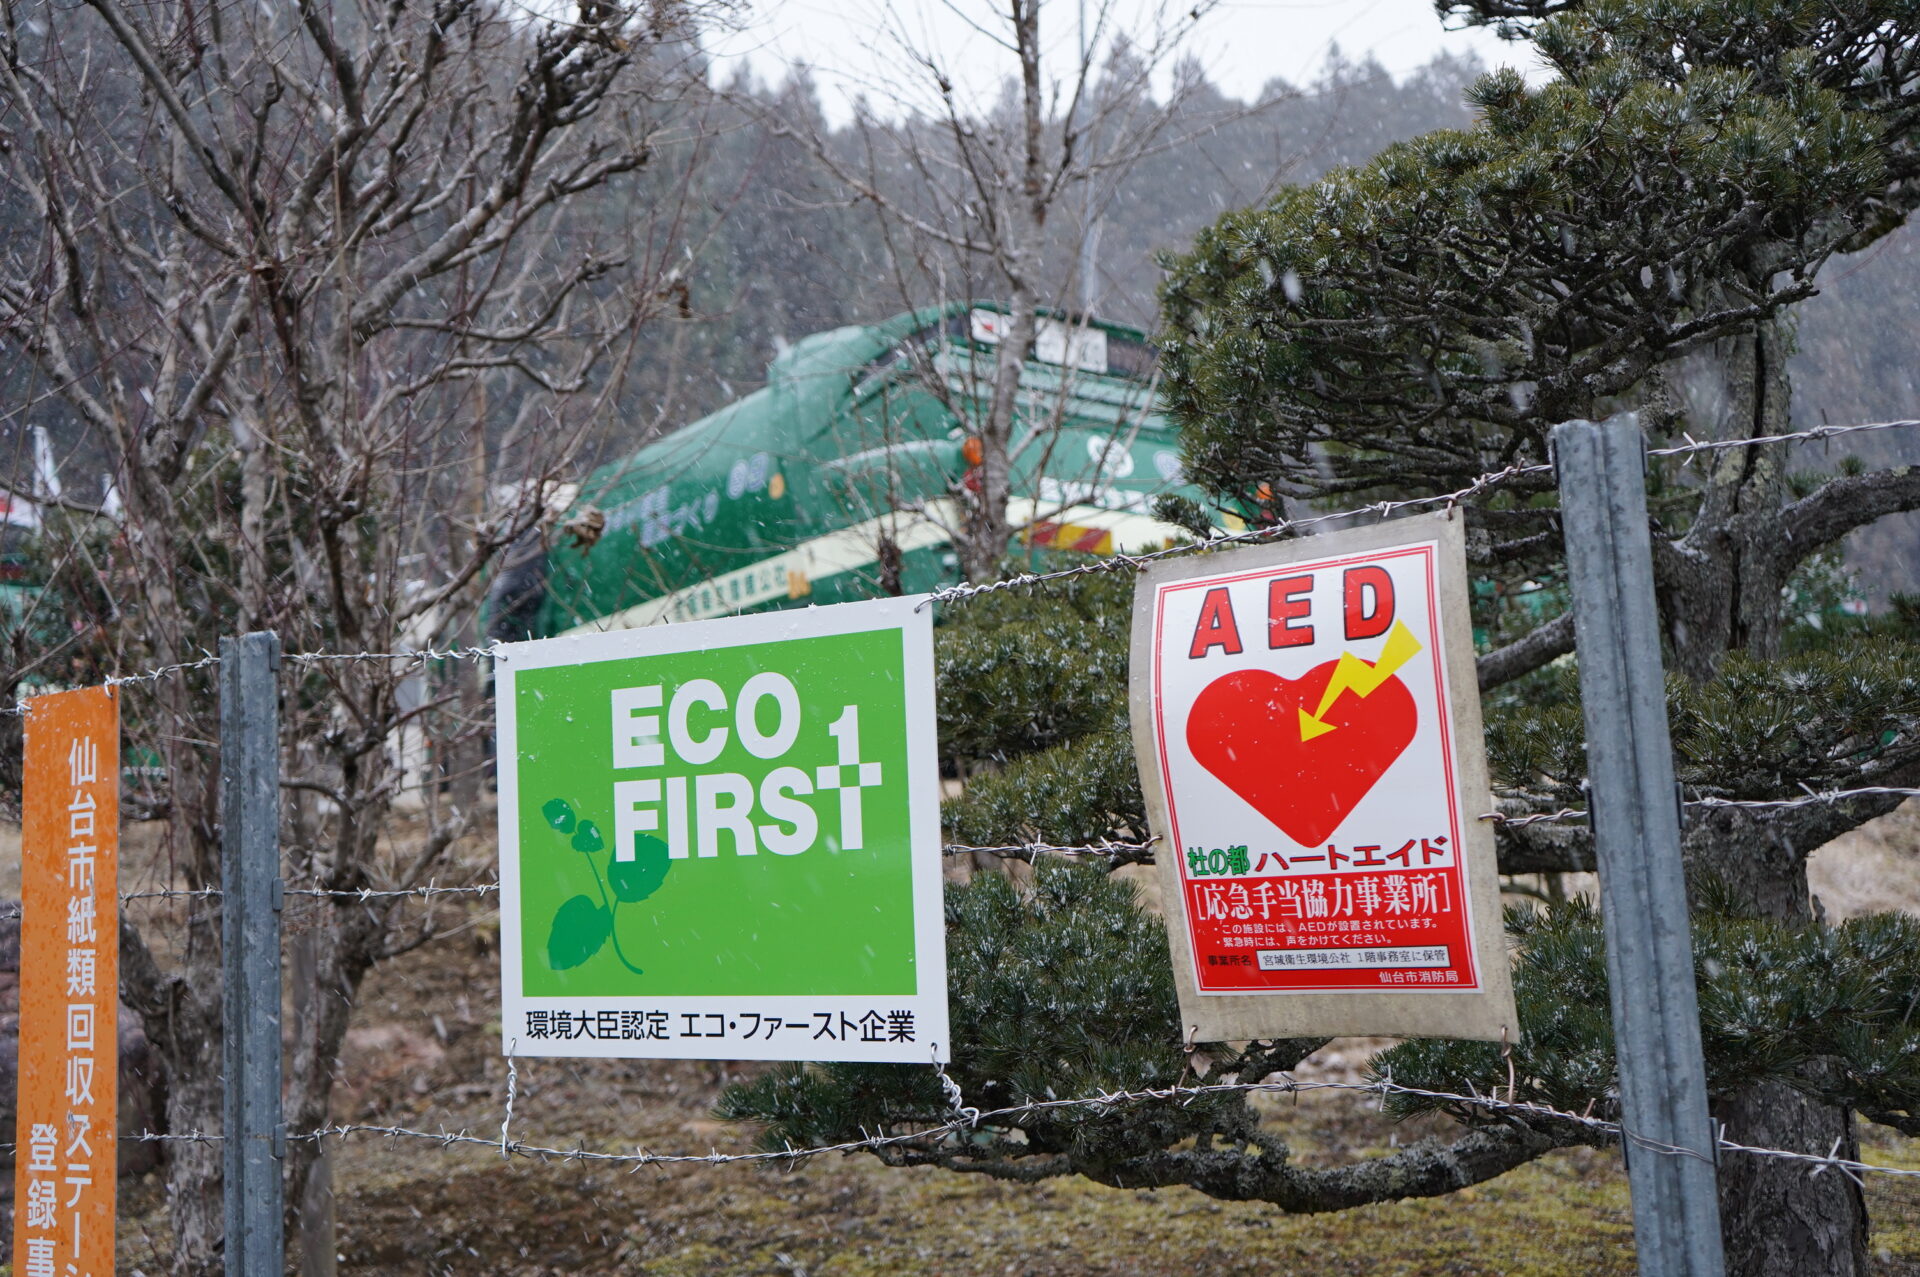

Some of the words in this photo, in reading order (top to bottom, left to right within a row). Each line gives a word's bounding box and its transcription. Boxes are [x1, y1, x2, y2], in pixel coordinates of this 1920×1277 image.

[1189, 565, 1396, 660] AED
[611, 672, 801, 769] ECO
[613, 761, 883, 862] FIRST
[1187, 844, 1251, 877] 杜の都
[1254, 835, 1449, 873] ハートエイド
[1207, 954, 1252, 967] 事業所名
[1378, 970, 1459, 984] 仙台市消防局
[525, 1009, 670, 1041] 環境大臣認定
[679, 1009, 916, 1043] エコ・ファースト企業
[26, 1123, 58, 1277] 登録事
